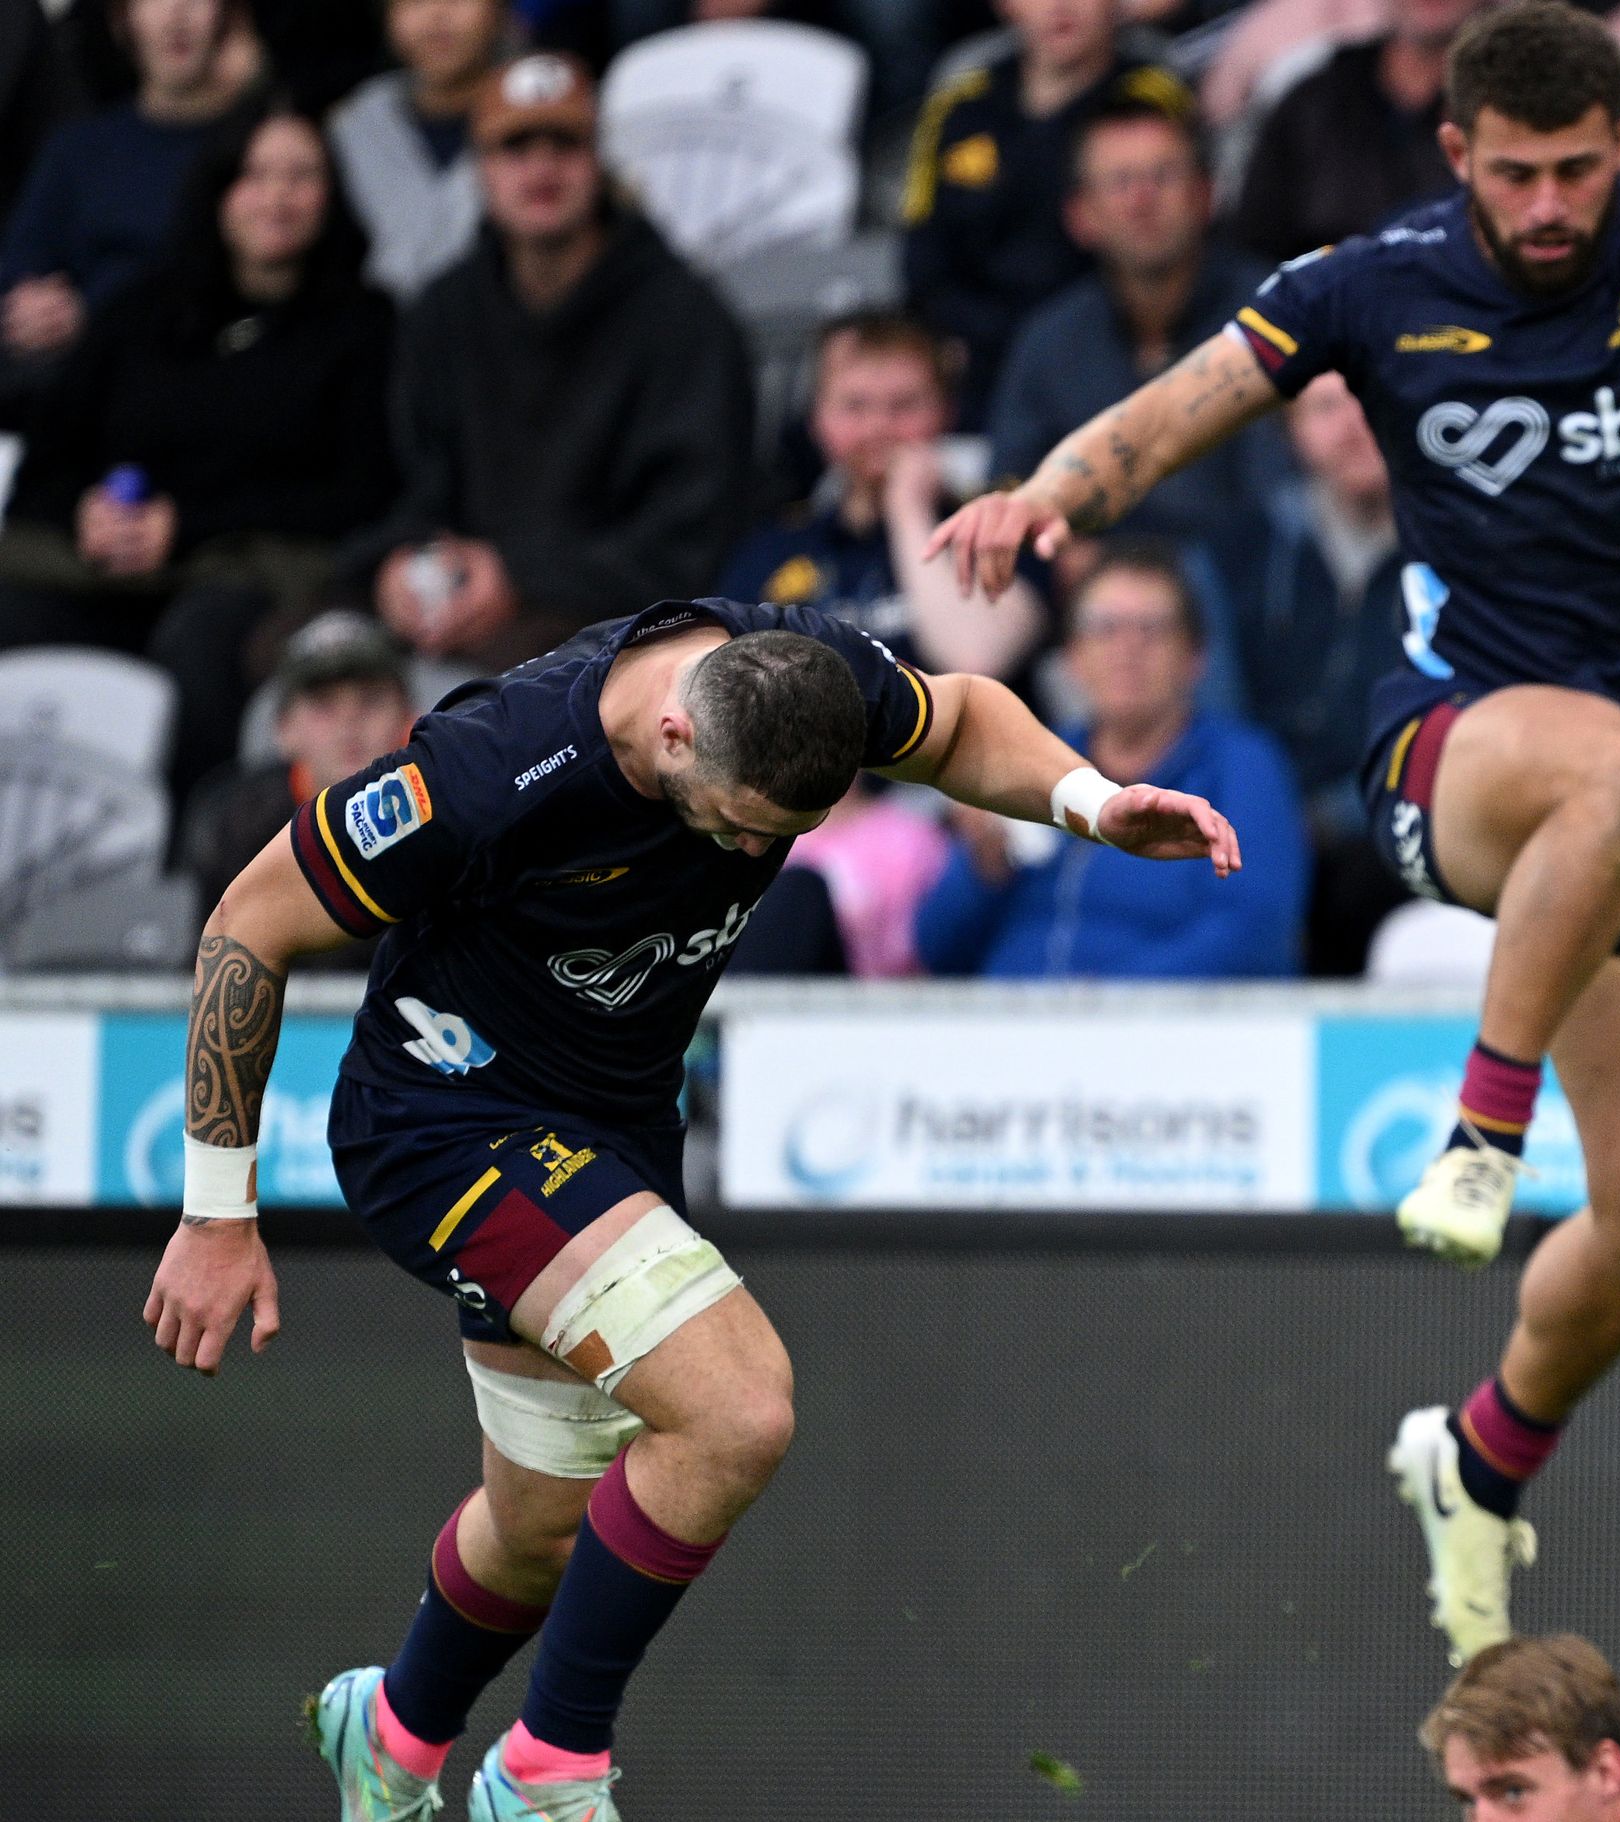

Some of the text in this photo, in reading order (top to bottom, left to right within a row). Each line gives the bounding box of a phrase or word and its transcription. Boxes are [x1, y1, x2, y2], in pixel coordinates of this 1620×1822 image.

[514, 744, 578, 791] SPEIGHT'S
[677, 894, 764, 966] sb
[893, 1085, 1258, 1147] harrisons
